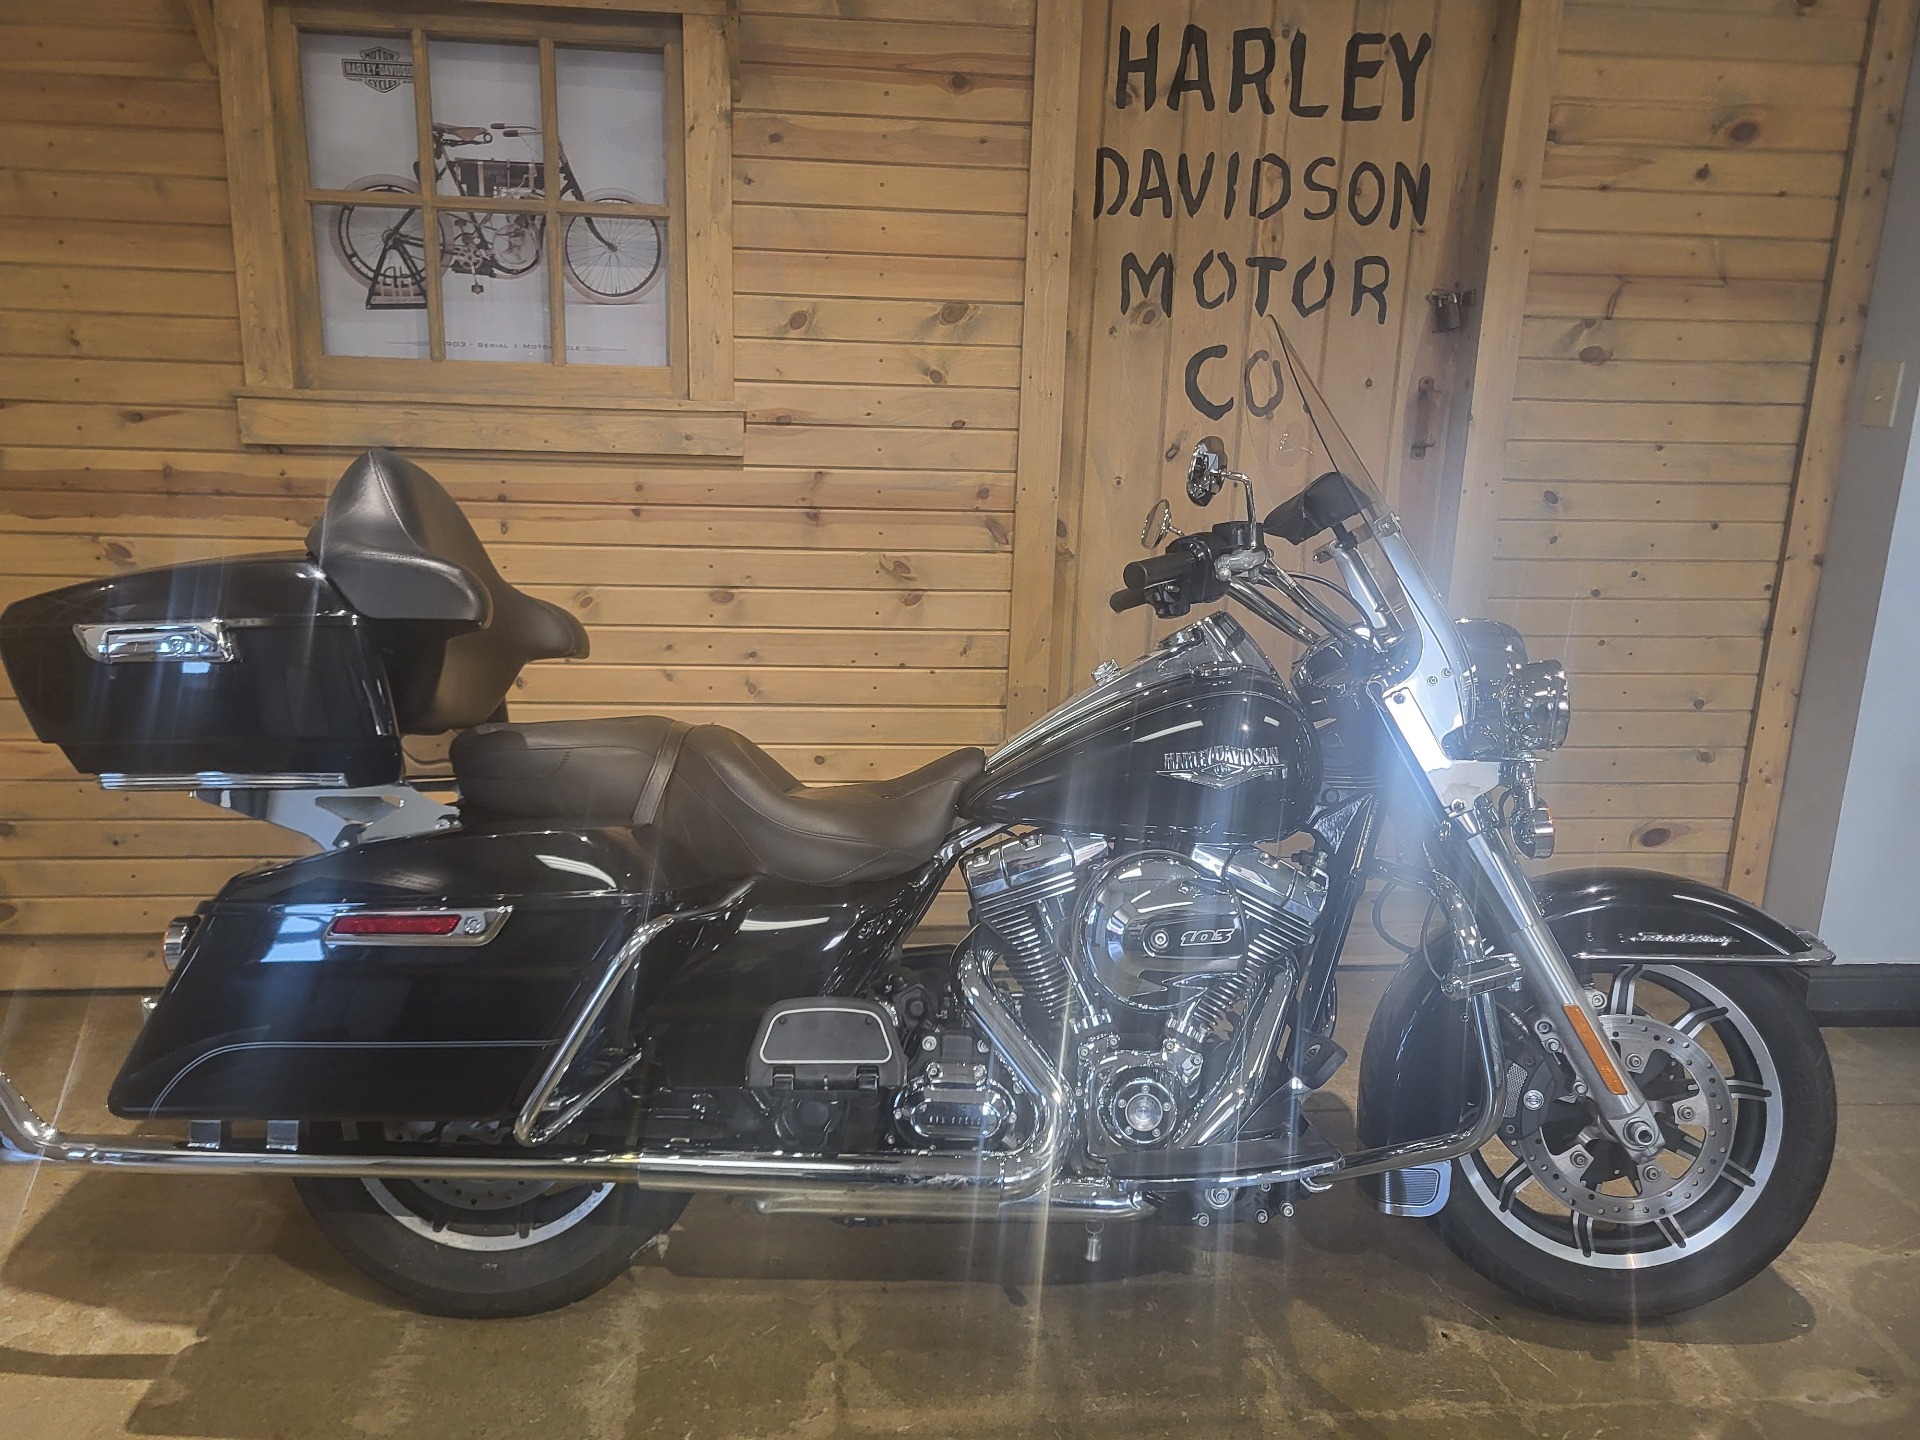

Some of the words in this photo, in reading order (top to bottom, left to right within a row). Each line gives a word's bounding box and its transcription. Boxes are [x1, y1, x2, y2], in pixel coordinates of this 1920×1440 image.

[363, 49, 395, 60] MOTOR
[345, 62, 414, 77] HARLEY-DAVIDSO
[1115, 23, 1432, 121] HARLEY
[367, 79, 398, 90] CYCLES
[1093, 146, 1430, 230] DAVIDSON
[1120, 249, 1390, 325] MOTOR
[1180, 928, 1235, 947] 103
